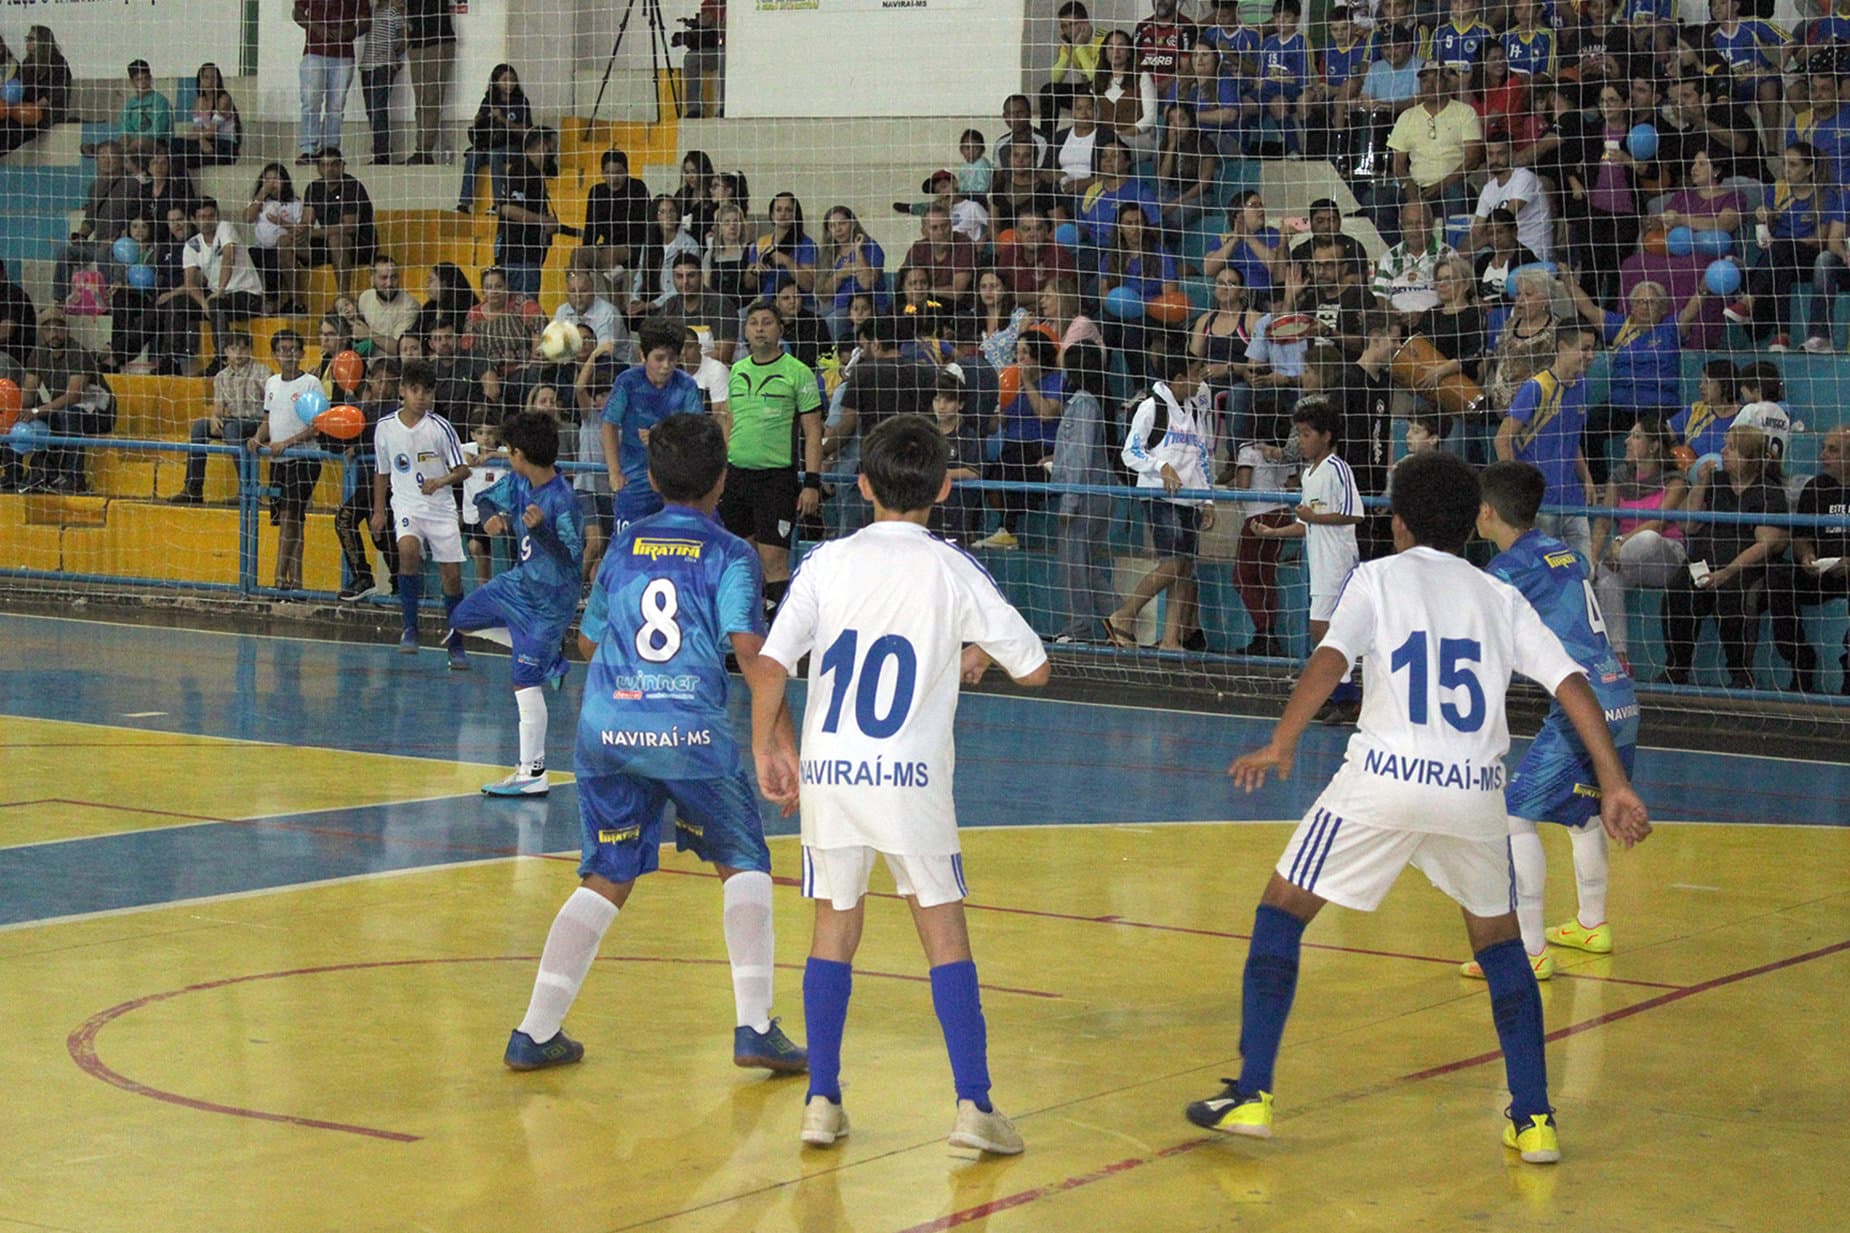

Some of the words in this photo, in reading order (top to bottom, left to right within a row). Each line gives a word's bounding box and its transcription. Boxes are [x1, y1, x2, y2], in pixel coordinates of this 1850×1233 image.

[1445, 35, 1453, 48] 5
[402, 517, 409, 527] 9
[635, 577, 682, 663] 8
[1582, 579, 1609, 642] 4
[820, 628, 918, 739] 10
[1391, 630, 1486, 733] 15
[601, 726, 711, 747] NAVIRAÍ-MS
[799, 754, 929, 788] NAVIRAÍ-MS
[1364, 748, 1504, 792] NAVIRAÍ-MS
